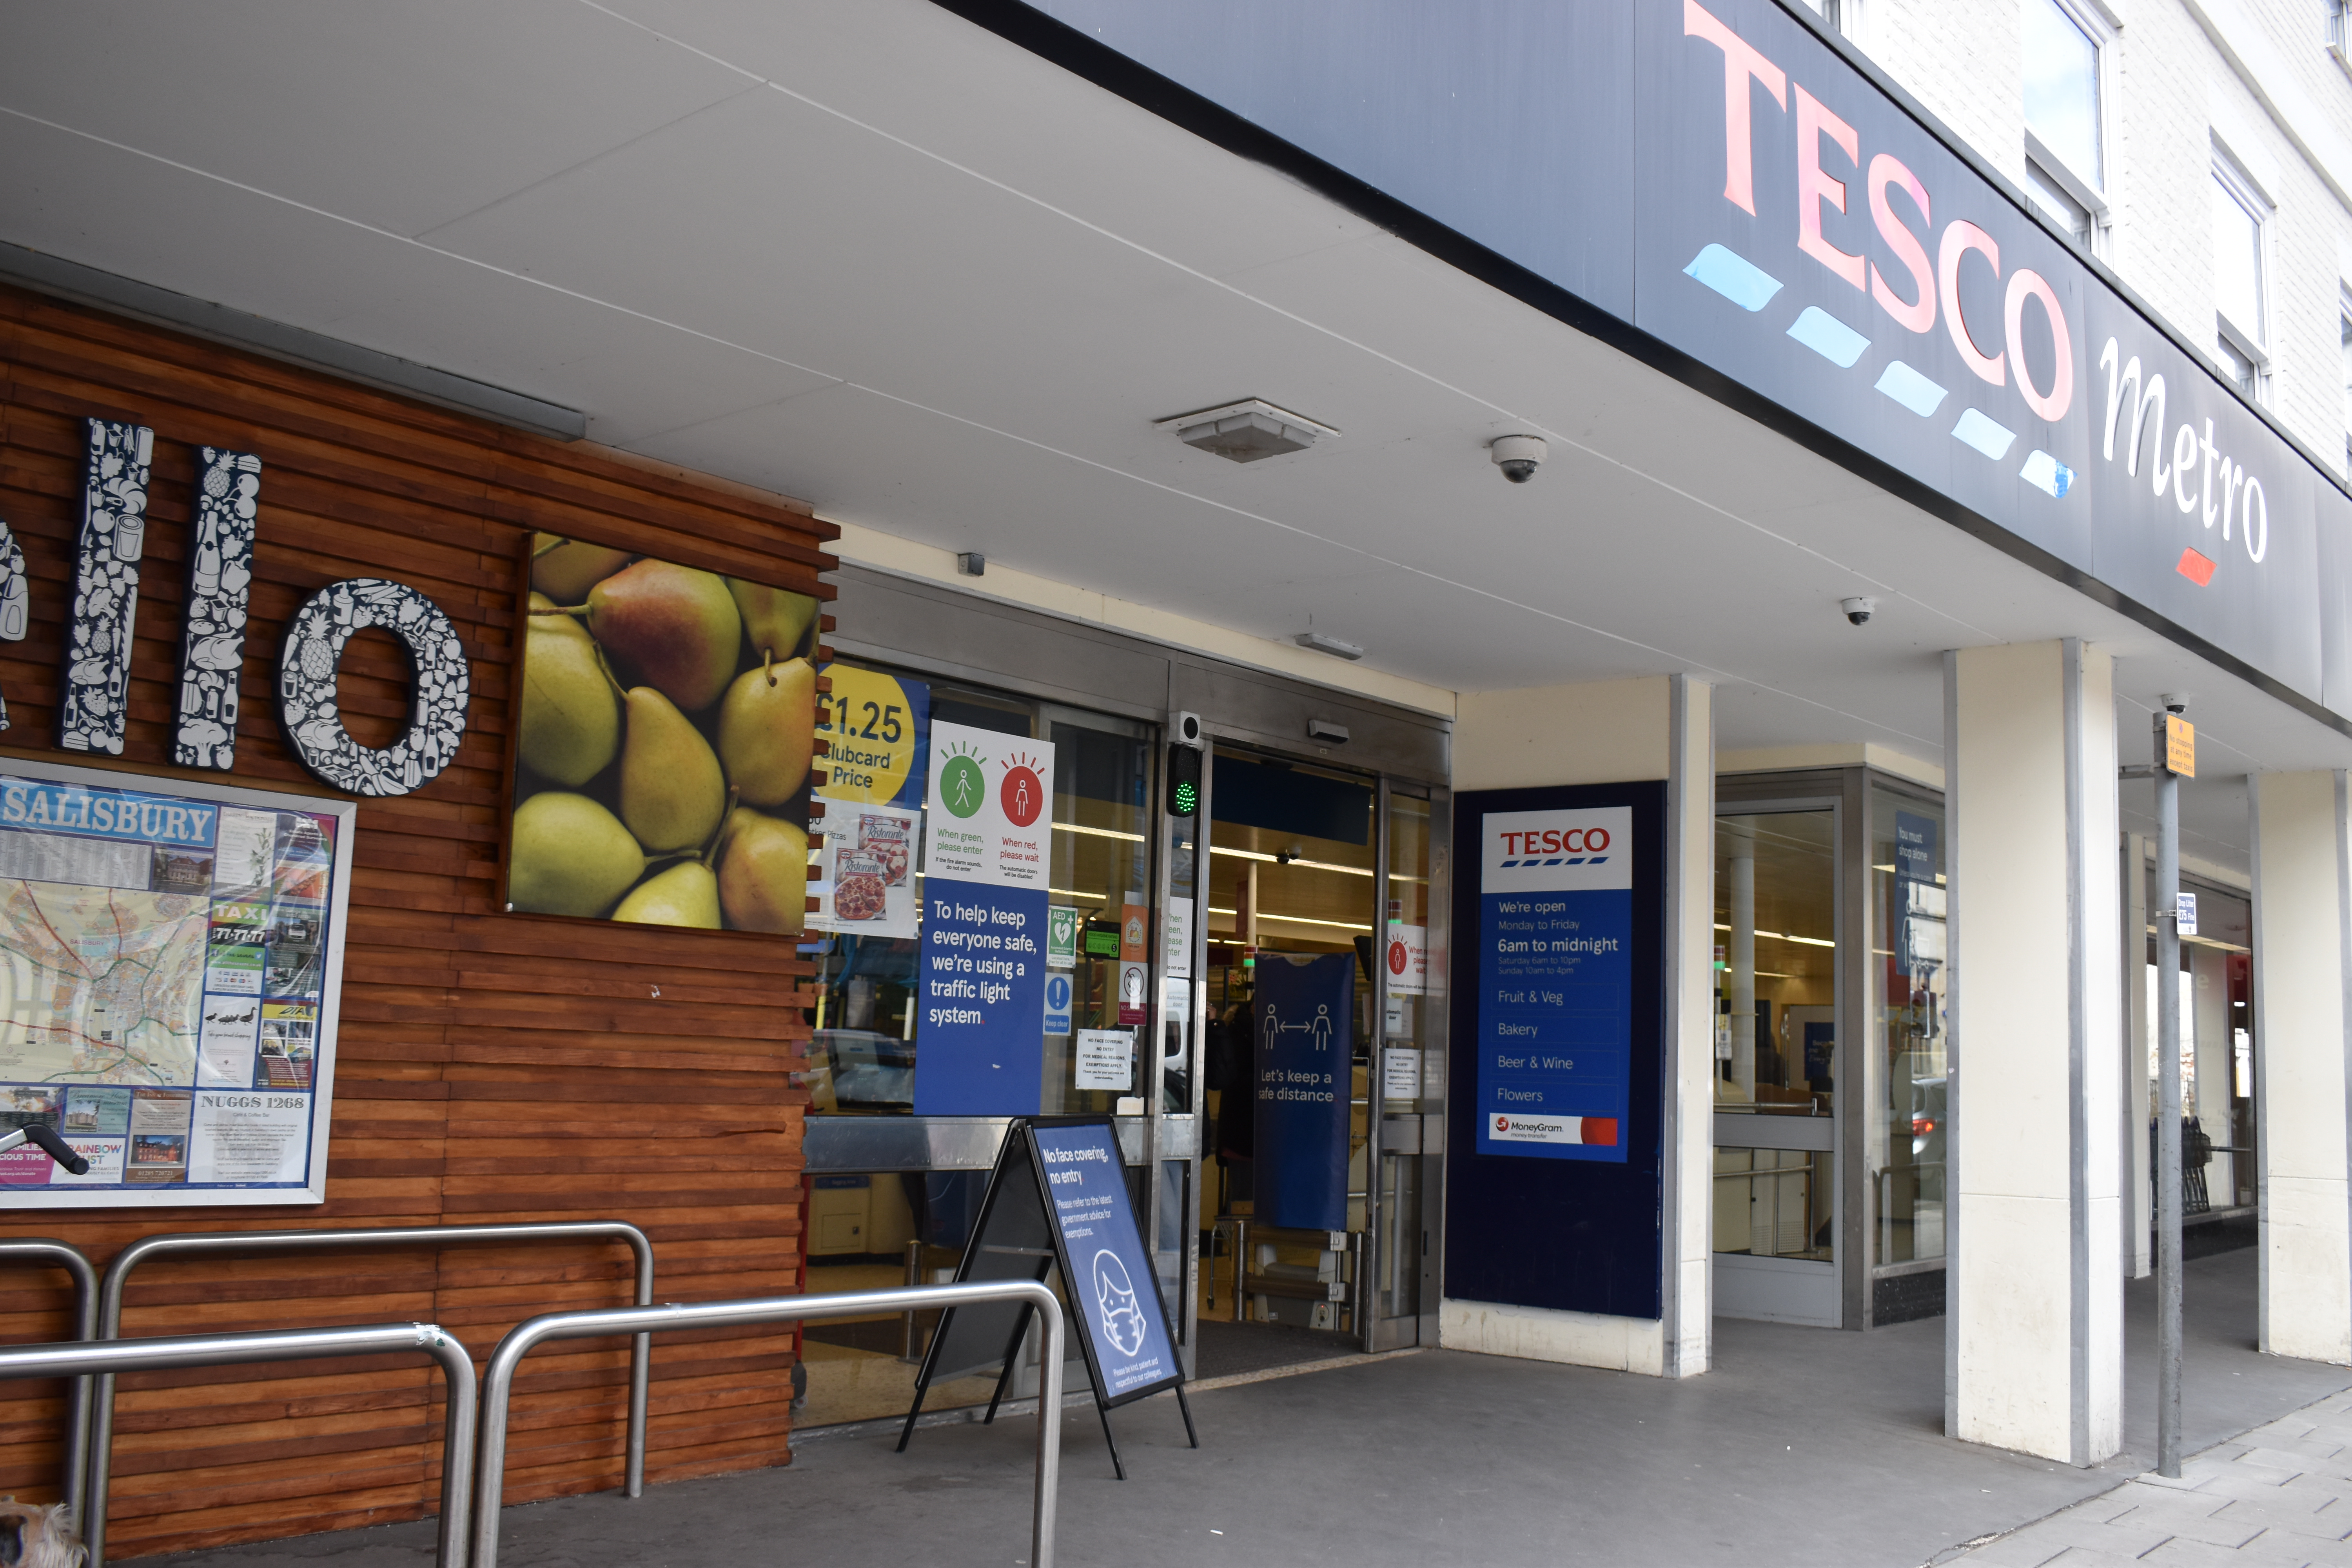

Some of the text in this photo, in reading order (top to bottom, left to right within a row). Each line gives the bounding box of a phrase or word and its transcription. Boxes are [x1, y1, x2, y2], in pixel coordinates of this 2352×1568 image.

[1684, 0, 2073, 422] TESCO
[0, 417, 470, 797] llo
[815, 692, 901, 743] £1.25
[2169, 734, 2192, 751] No stopping
[2183, 750, 2192, 760] time
[2170, 759, 2192, 772] except taxis
[833, 766, 873, 788] Price
[3, 787, 212, 842] SALISBURY
[828, 830, 846, 840] Pizzas
[867, 825, 903, 839] Ristorante
[938, 828, 983, 843] When green,
[1898, 826, 1922, 844] You must
[937, 842, 983, 855] please enter
[1002, 837, 1038, 851] When red,
[1500, 828, 1610, 855] TESCO
[1000, 850, 1039, 862] please wait
[1899, 844, 1912, 860] shop
[844, 859, 880, 872] Ristorante
[215, 904, 267, 921] TAXI
[934, 900, 1025, 930] To help keep
[1053, 911, 1065, 920] AED
[1499, 902, 1566, 915] We're open
[1169, 914, 1182, 923] hen
[1499, 920, 1580, 932] Monday to Friday
[933, 931, 1036, 955] everyone safe,
[1409, 946, 1423, 954] When
[1498, 937, 1618, 955] 6am to midnight
[932, 954, 1024, 980] we're using a
[1498, 956, 1530, 965] Saturday
[1560, 956, 1581, 966] 10pm
[1498, 967, 1523, 975] Sunday
[1556, 967, 1573, 975] 4pm
[931, 979, 1010, 1004] traffic light
[1499, 991, 1563, 1005] Fruit & Veg
[279, 1007, 305, 1015] DTA
[929, 1006, 985, 1027] system.
[1499, 1023, 1538, 1038] Bakery
[1498, 1055, 1573, 1069] Beer & Wine
[1261, 1069, 1331, 1086] Let's keep a
[1259, 1087, 1274, 1100] safe
[1498, 1088, 1543, 1102] Flowers
[201, 1096, 304, 1109] NUGGS 1268
[1511, 1122, 1562, 1133] MoneyGram
[1043, 1145, 1108, 1163] No face covering,
[1049, 1172, 1061, 1184] no
[1056, 1194, 1113, 1209] Please refer to the latest
[1061, 1212, 1090, 1226] government
[1089, 1210, 1105, 1221] advice
[1065, 1227, 1094, 1240] exemptions.
